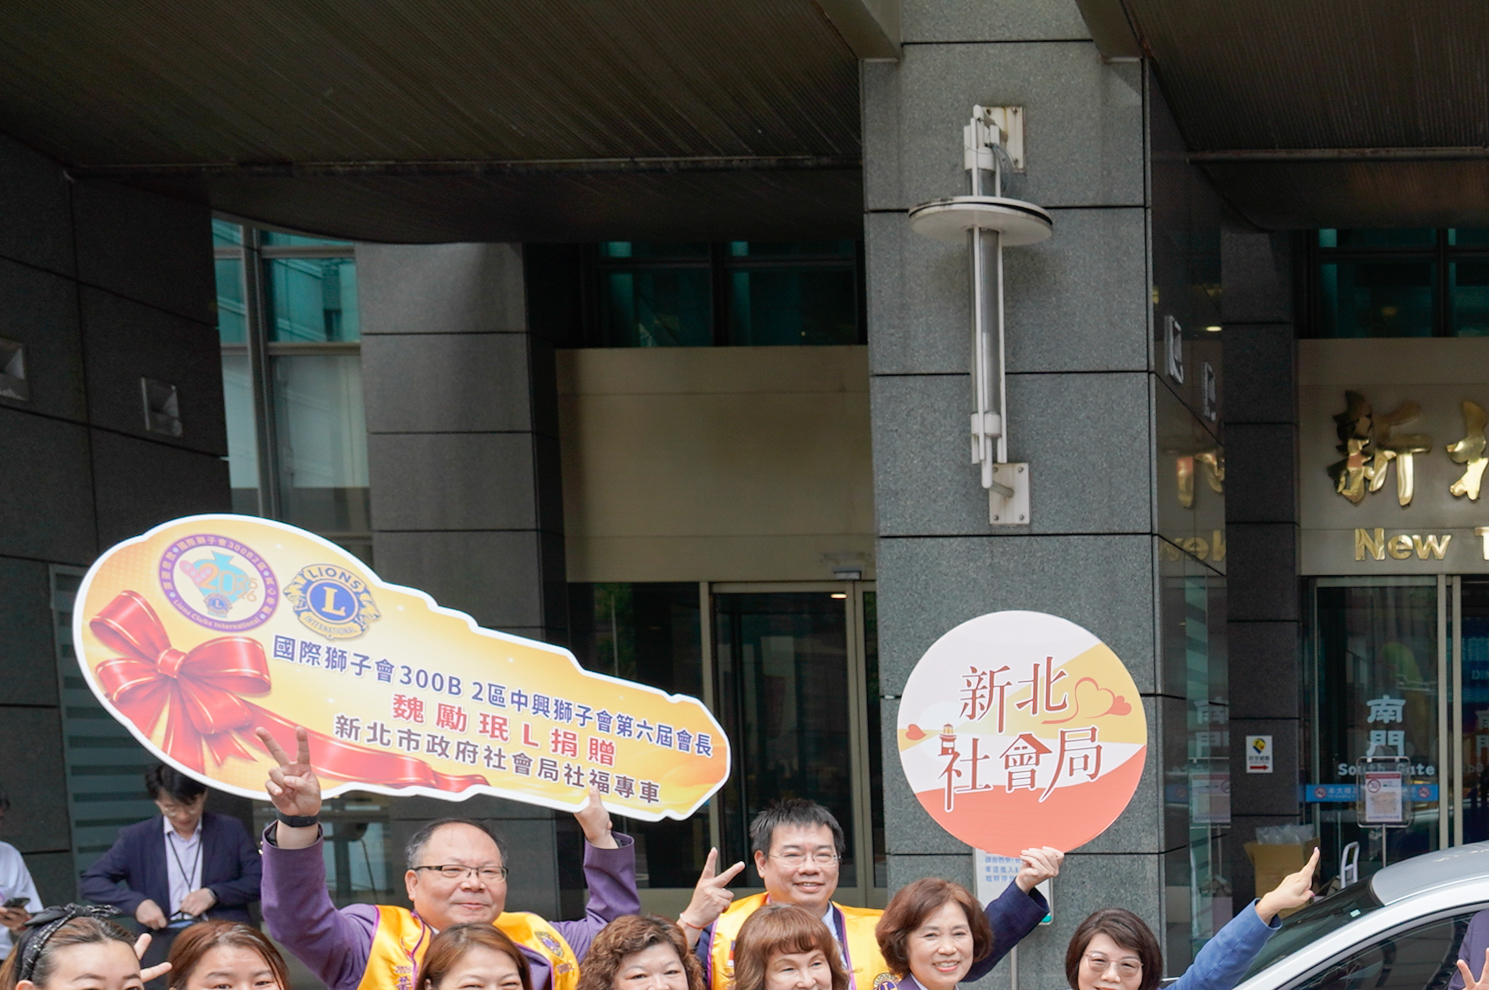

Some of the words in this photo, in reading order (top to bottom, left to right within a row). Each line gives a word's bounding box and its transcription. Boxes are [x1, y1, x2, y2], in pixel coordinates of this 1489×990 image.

[1354, 527, 1451, 561] New
[308, 567, 361, 590] LIONS
[322, 586, 346, 616] L
[303, 614, 357, 636] INTERNATIONAL
[959, 656, 1068, 733] 新北
[1366, 694, 1406, 757] 南門
[334, 714, 660, 805] 新北市政府社會局社福專車
[937, 726, 1103, 811] 社會局
[1338, 763, 1386, 777] South
[1396, 763, 1436, 777] Gate
